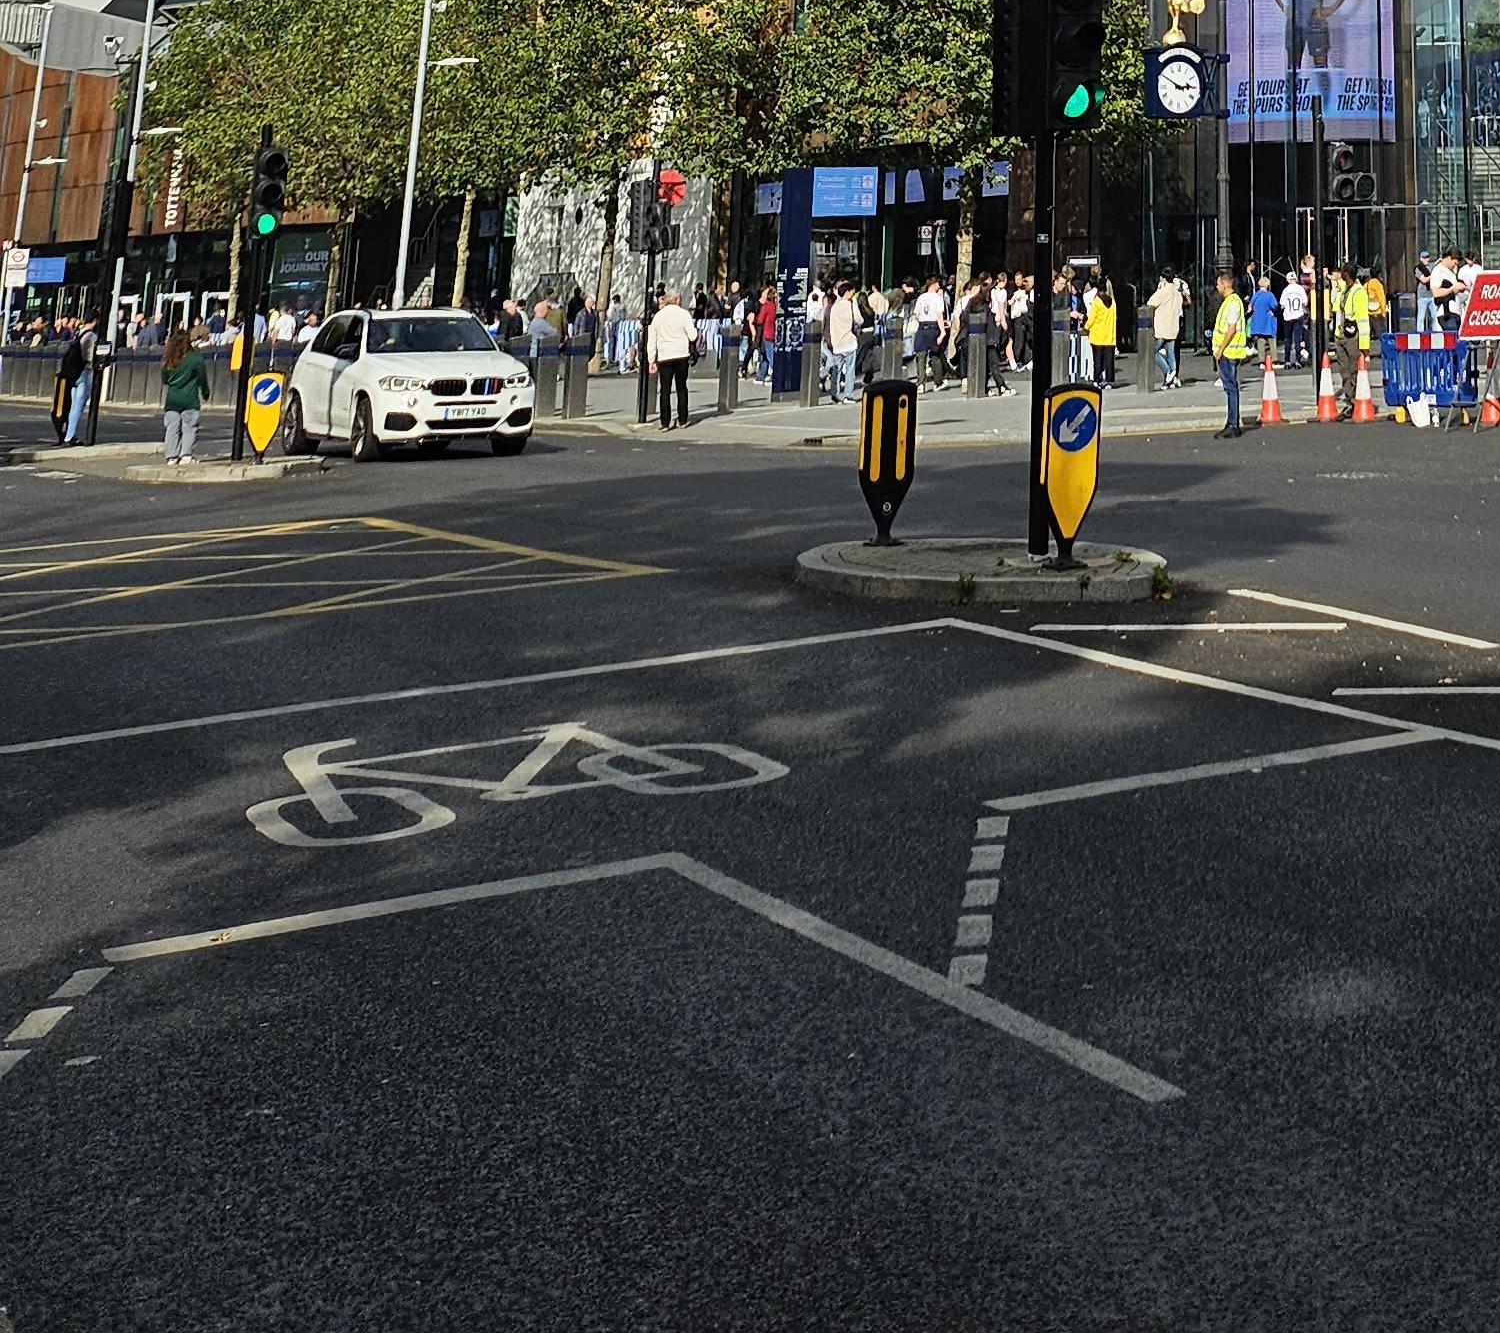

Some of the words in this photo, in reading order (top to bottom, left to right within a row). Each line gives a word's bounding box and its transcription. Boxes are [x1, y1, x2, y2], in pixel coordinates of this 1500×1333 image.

[1238, 81, 1249, 98] GE
[1344, 77, 1363, 94] GET
[1232, 97, 1248, 115] THE
[1254, 96, 1284, 114] PURS
[1337, 94, 1356, 111] THE
[305, 251, 329, 262] OUR
[279, 262, 329, 273] JOURNEY
[1288, 297, 1301, 313] 10
